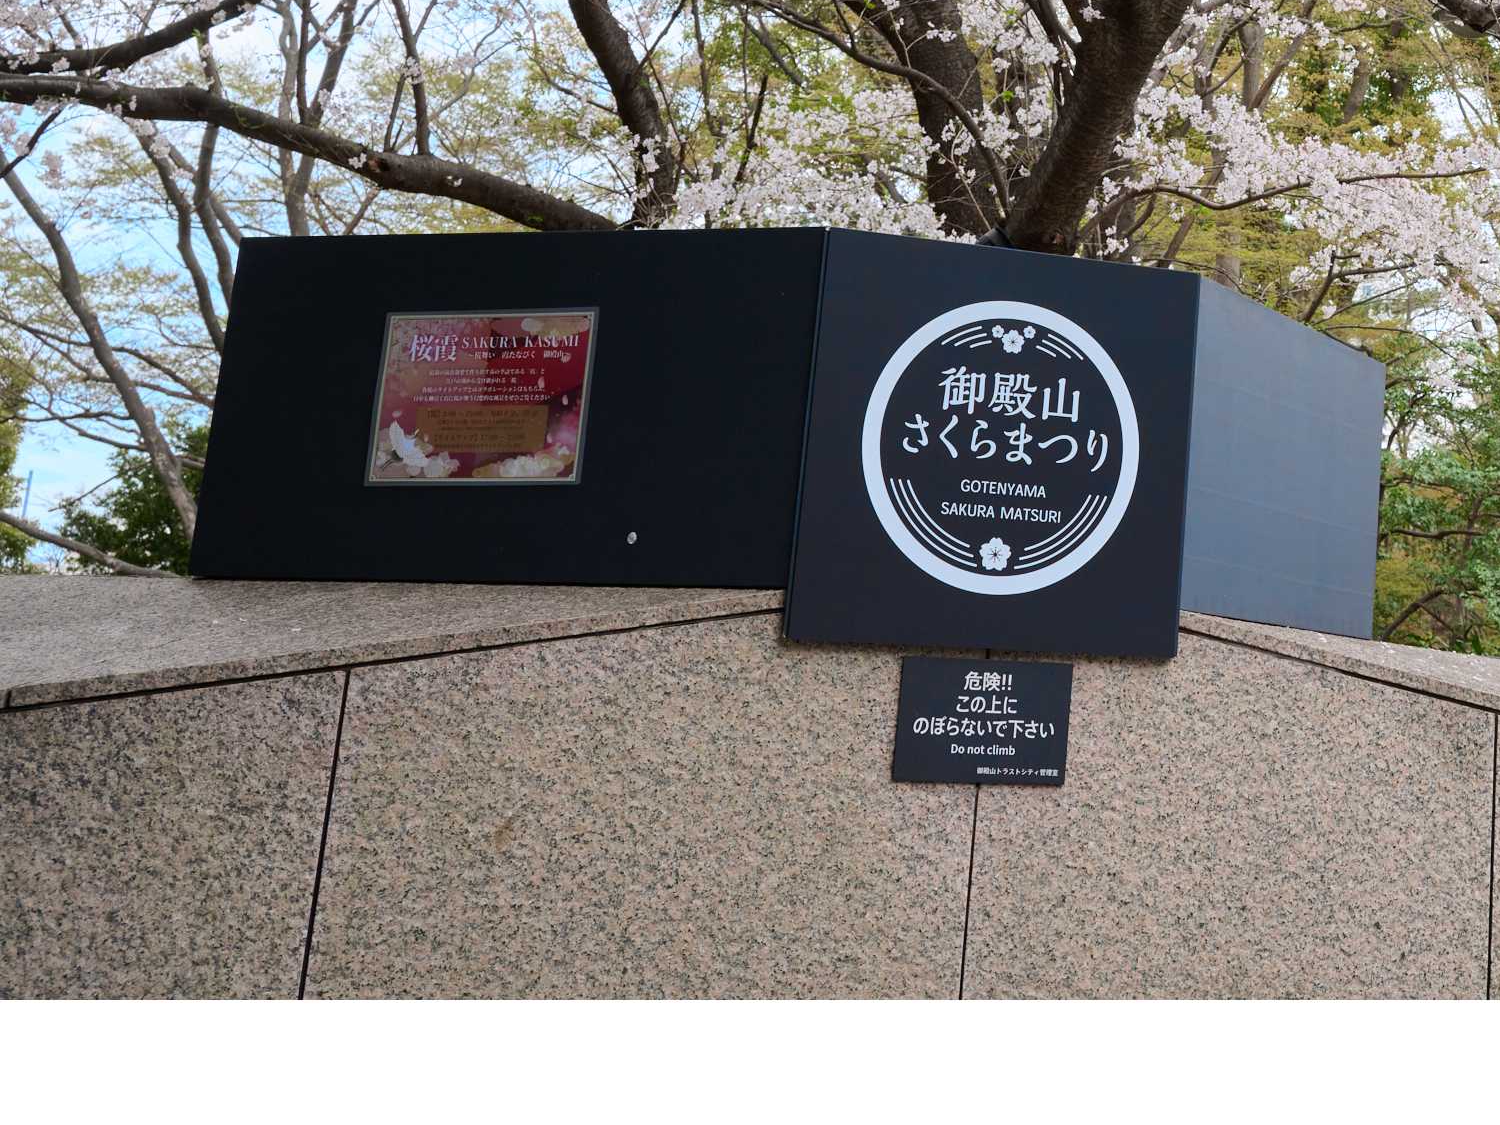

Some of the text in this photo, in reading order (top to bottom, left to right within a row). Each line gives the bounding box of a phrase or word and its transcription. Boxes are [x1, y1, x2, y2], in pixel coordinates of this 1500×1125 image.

[408, 334, 458, 362] 桜霞
[461, 334, 579, 349] SAKURA KASUMI
[938, 365, 1081, 422] 御殿山
[902, 413, 1109, 472] さくらまつり
[960, 479, 1046, 498] GOTENYAMA
[941, 501, 1061, 524] SAKURA MATSURI
[963, 671, 1013, 692] 危険!!
[956, 695, 1018, 714] この上に
[913, 717, 1055, 738] のぼらないで下さい
[951, 744, 1016, 756] Do not climb
